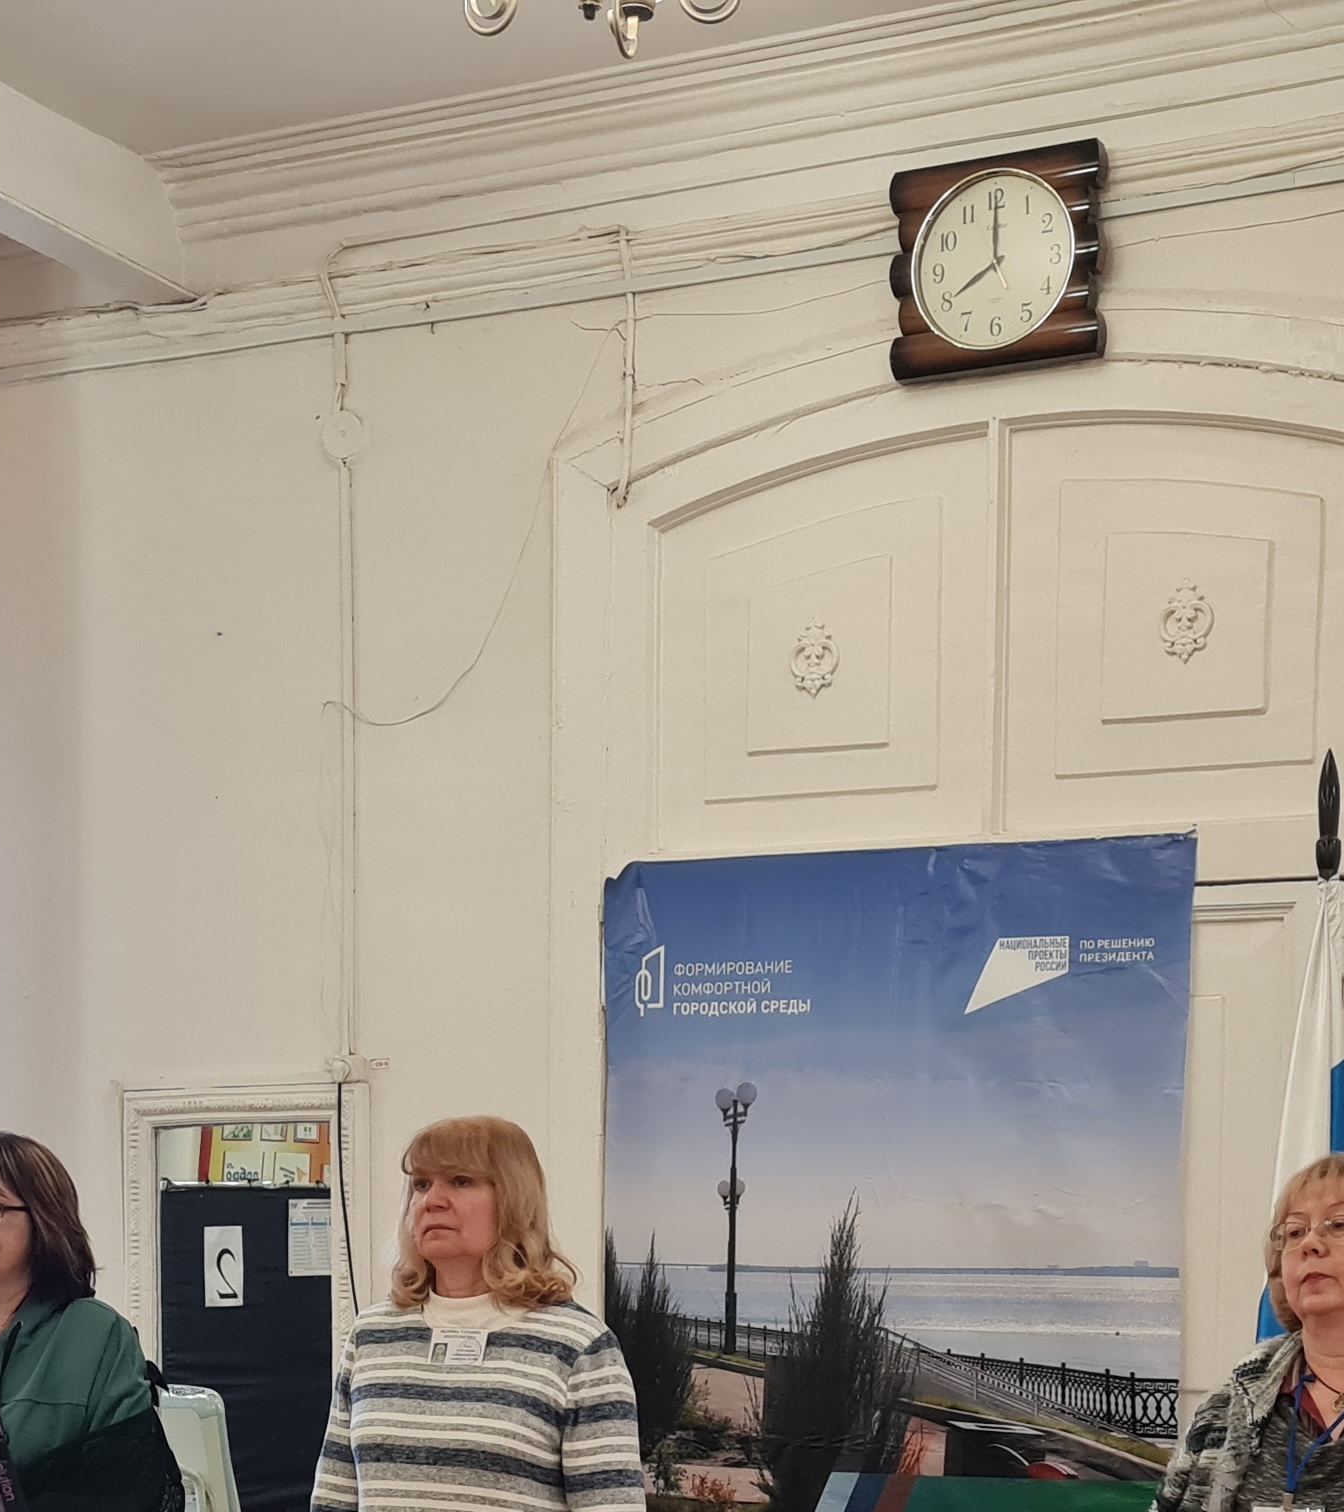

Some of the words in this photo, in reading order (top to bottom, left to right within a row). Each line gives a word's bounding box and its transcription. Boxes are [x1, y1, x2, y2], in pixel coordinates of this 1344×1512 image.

[962, 203, 976, 225] 11
[1024, 194, 1031, 215] 1
[1041, 212, 1054, 234] 2
[940, 230, 958, 252] 10
[1050, 243, 1062, 265] 3
[932, 263, 945, 284] 9
[1040, 275, 1053, 296] 4
[941, 291, 954, 312] 8
[1019, 301, 1033, 323] 5
[960, 310, 973, 332] 7
[989, 316, 1003, 337] 6
[999, 938, 1068, 951] НАЦИОНАЛЬНЫЕ
[1079, 939, 1095, 950] ПО
[1097, 937, 1155, 949] РЕШЕНИЮ
[1028, 950, 1067, 961] ПРОЕКТЫ
[1079, 951, 1155, 963] ПРЕЗИДЕНТА
[673, 960, 793, 977] ФОРМИРОВАНИЕ
[1034, 961, 1067, 972] РОССИИ
[672, 978, 771, 996] КОМФОРТНОЙ
[672, 998, 757, 1017] ГОРОДСКОЙ
[760, 998, 811, 1015] СРЕДЫ
